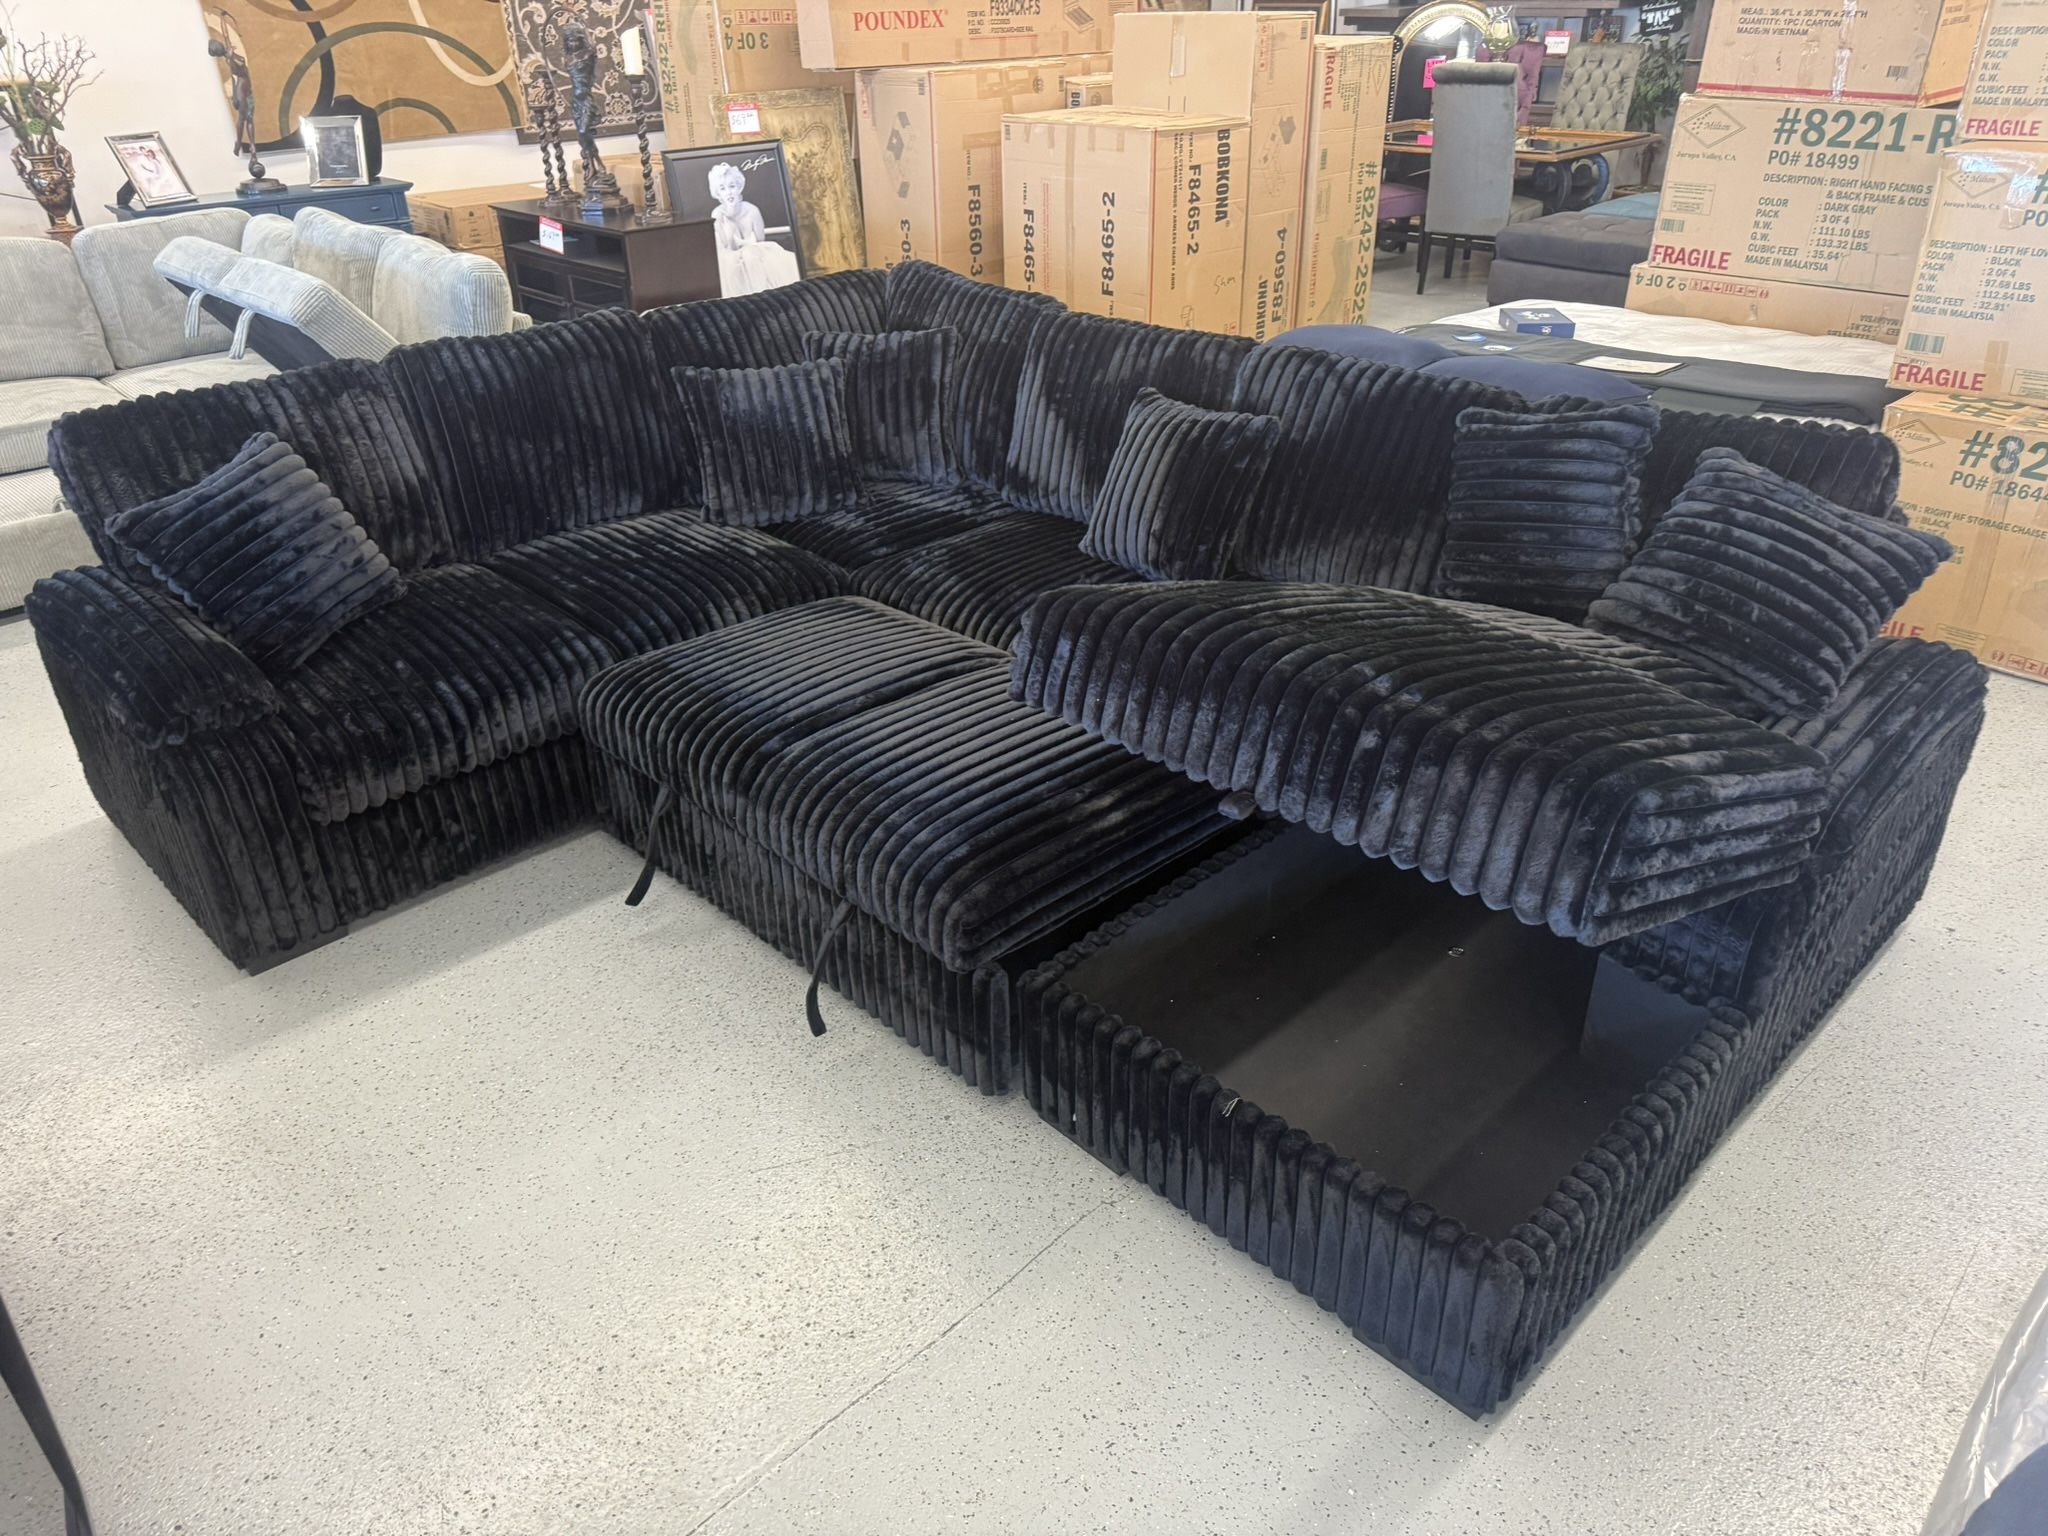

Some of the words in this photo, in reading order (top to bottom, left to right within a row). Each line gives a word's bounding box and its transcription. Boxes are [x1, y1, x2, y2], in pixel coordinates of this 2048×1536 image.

[853, 9, 945, 32] POUNDEX
[1806, 19, 1842, 28] CARTON
[759, 32, 769, 49] 3
[1772, 28, 1809, 36] VIETNAM
[724, 32, 733, 50] 4
[737, 32, 756, 50] OF
[1987, 38, 2020, 48] COLOR
[1984, 50, 2009, 60] PACK
[1975, 85, 2005, 95] CUBIC
[2005, 85, 2028, 95] FEET
[1972, 96, 2000, 106] MADE
[1772, 106, 1955, 154] #8221-R
[1965, 118, 2042, 137] FRAGILE
[1724, 152, 1737, 161] CA
[1768, 150, 1802, 166] PO#
[1805, 151, 1859, 170] 18499
[1214, 128, 1230, 223] BOBKONA
[1830, 177, 1859, 189] RIGHT
[1859, 179, 1886, 192] HAND
[1887, 182, 1922, 194] FACING
[1758, 196, 1789, 208] COLOR
[1824, 201, 1850, 213] DARK
[1851, 204, 1878, 216] GRAY
[1826, 189, 1834, 199] &
[1835, 190, 1862, 202] BACK
[1863, 193, 1897, 205] FRAME
[1897, 196, 1905, 205] &
[1906, 196, 1930, 207] CUS
[1186, 163, 1202, 256] F8465-2
[1755, 208, 1780, 219] PACK
[1821, 214, 1828, 223] 3
[1829, 214, 1843, 225] OF
[1844, 215, 1850, 225] 4
[967, 184, 984, 277] F8560-3
[1752, 220, 1773, 231] N.W.
[1818, 226, 1851, 238] 111.10
[1851, 229, 1871, 240] LBS
[1101, 191, 1116, 297] F8465-2
[1747, 243, 1776, 254] CUBIC
[1776, 246, 1799, 257] FEET
[1750, 232, 1770, 242] G.W.
[1815, 238, 1849, 250] 133.32
[1850, 241, 1869, 252] LBS
[1993, 244, 2016, 256] LEFT
[2016, 246, 2030, 256] HF
[1652, 244, 1732, 271] FRAGILE
[1744, 254, 1771, 266] MADE
[1772, 256, 1782, 267] IN
[1783, 258, 1829, 272] MALAYSIA
[1926, 250, 1955, 262] COLOR
[1989, 256, 2022, 267] BLACK
[1271, 226, 1288, 323] F8560-4
[1635, 272, 1644, 285] 4
[1921, 262, 1945, 272] PACK
[1987, 267, 1994, 276] 2
[1995, 268, 2009, 278] OF
[2009, 269, 2017, 279] 4
[1646, 274, 1663, 287] OF
[1666, 276, 1676, 289] 2
[2012, 280, 2032, 291] LBS
[1914, 294, 1942, 305] CUBIC
[1943, 297, 1965, 308] FEET
[2016, 293, 2036, 304] LBS
[1255, 279, 1268, 343] OBKONA
[1911, 305, 1938, 316] MADE
[1938, 307, 1948, 317] IN
[1949, 308, 1994, 321] MALAYSIA
[1893, 362, 1987, 392] FRAGILE
[1949, 470, 1989, 492] PO#
[1920, 516, 1952, 530] BLACK
[1923, 505, 1952, 519] RIGHT
[1968, 515, 2012, 532] STORAGE
[2011, 524, 2048, 540] CHAISE
